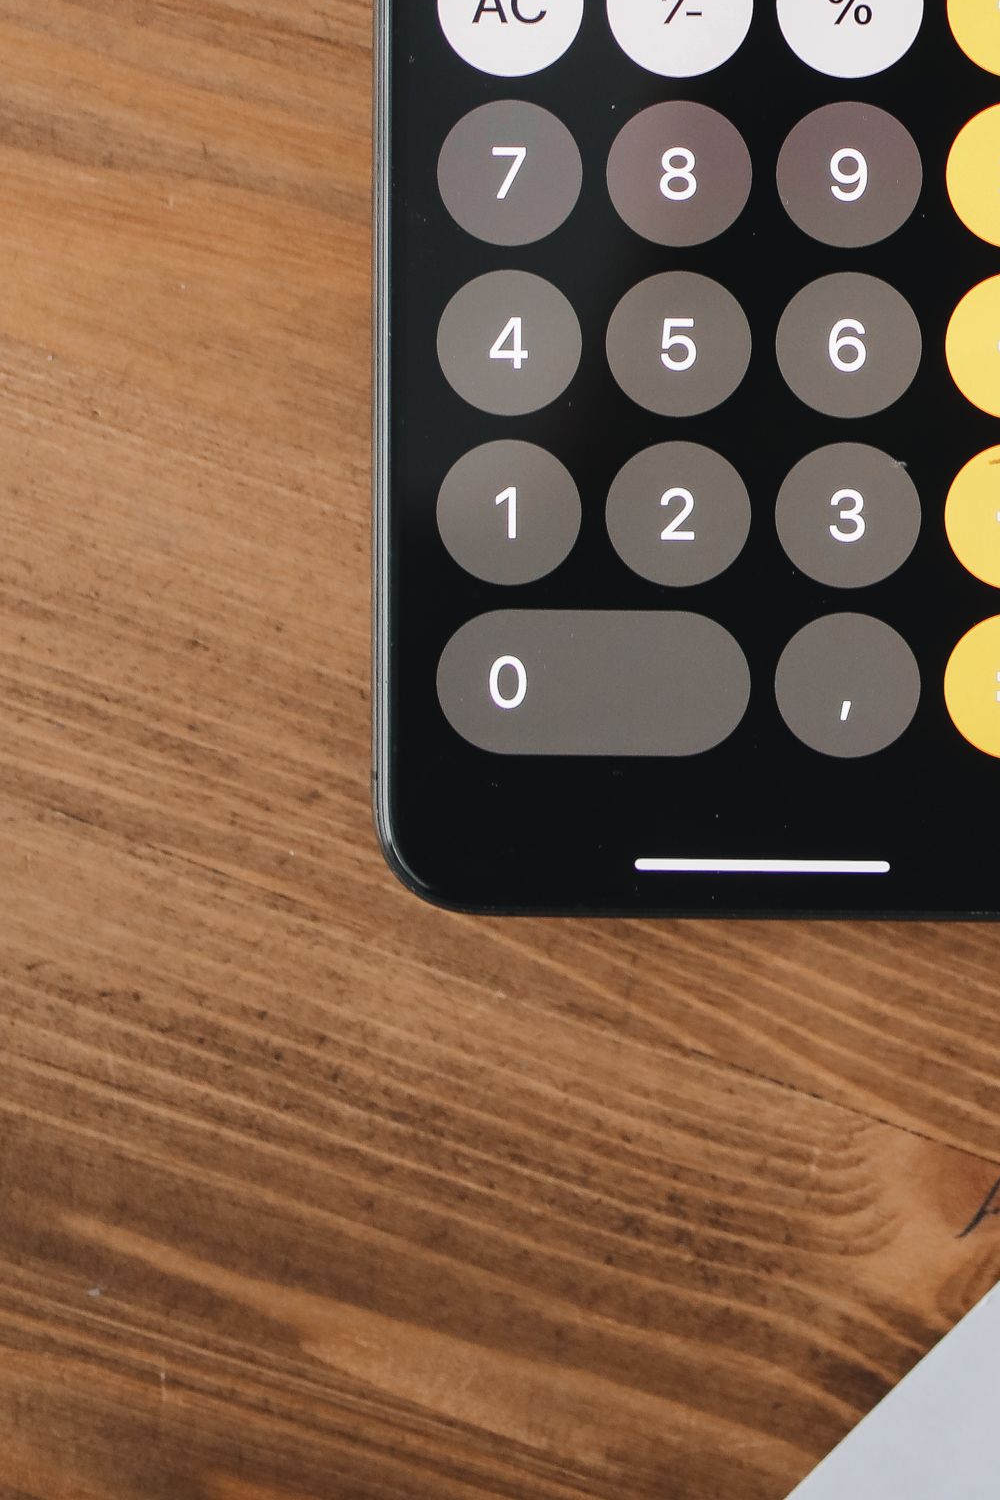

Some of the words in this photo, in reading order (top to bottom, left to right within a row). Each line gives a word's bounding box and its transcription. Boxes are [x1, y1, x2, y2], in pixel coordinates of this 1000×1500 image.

[492, 146, 527, 199] 7
[658, 147, 698, 201] 8
[829, 148, 868, 201] 9
[489, 317, 529, 369] 4
[660, 318, 697, 372] 5
[828, 318, 867, 372] 6
[495, 487, 518, 539] 1
[660, 488, 696, 541] 2
[829, 488, 866, 542] 3
[489, 655, 528, 709] 0
